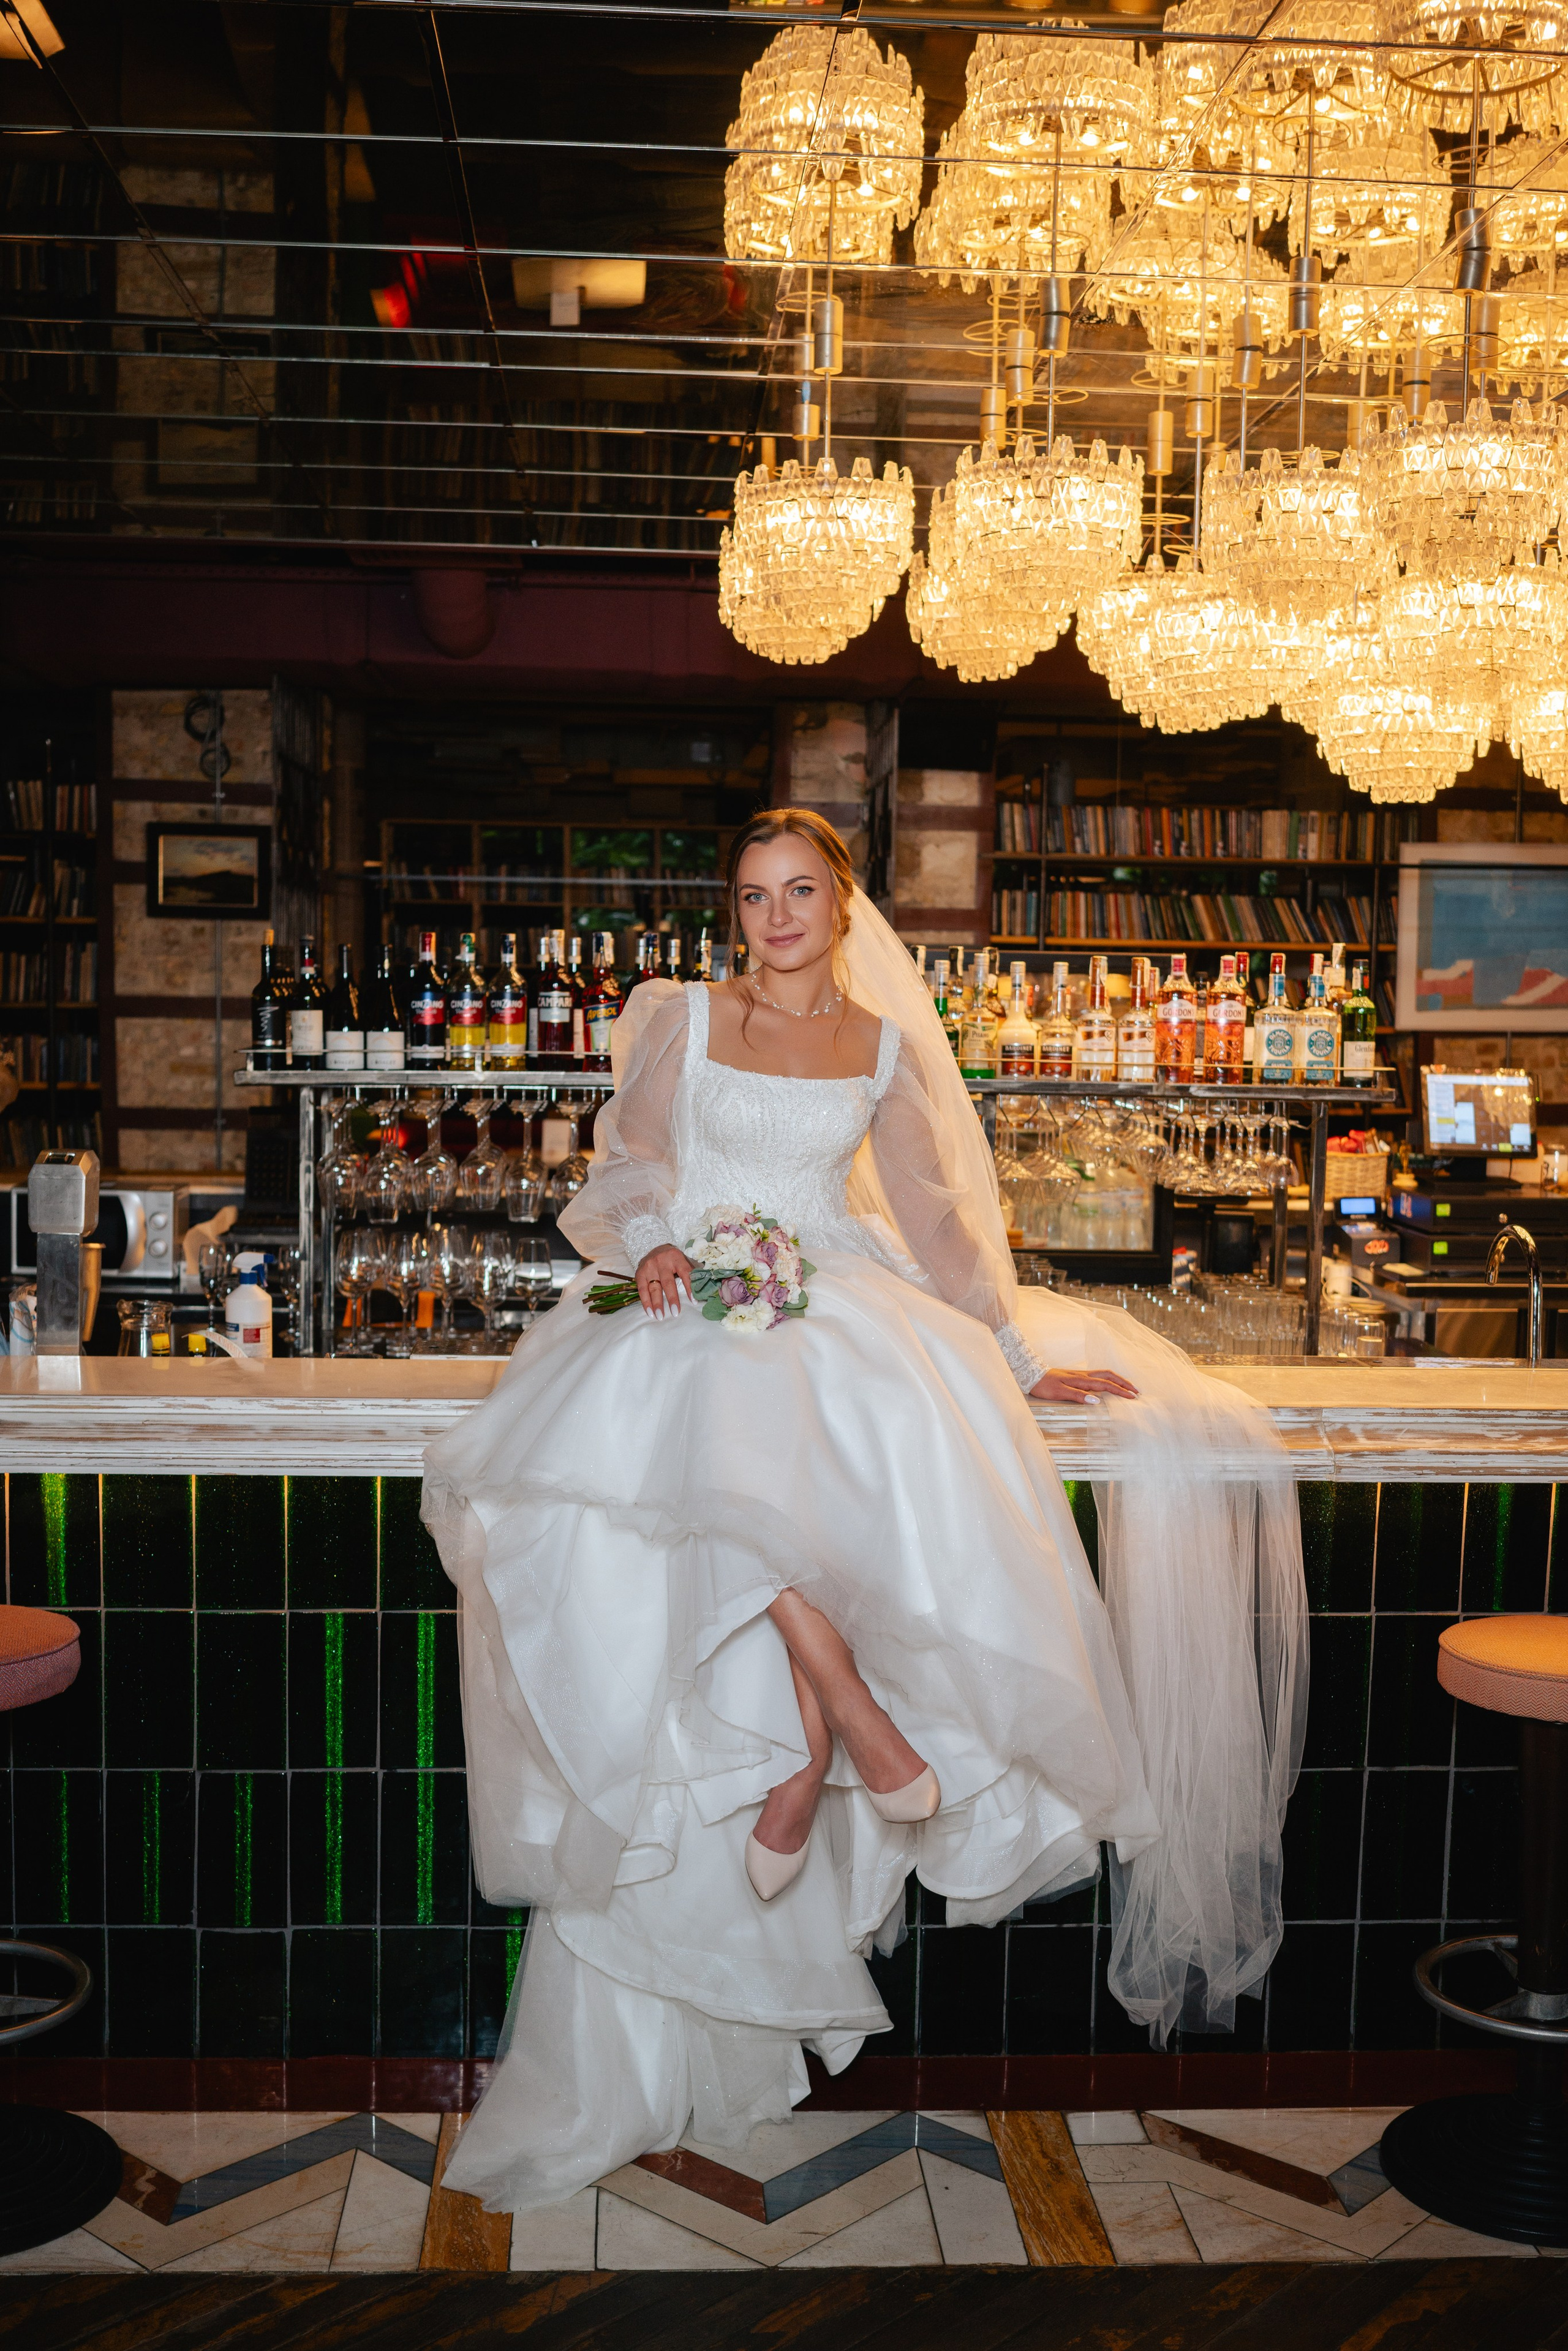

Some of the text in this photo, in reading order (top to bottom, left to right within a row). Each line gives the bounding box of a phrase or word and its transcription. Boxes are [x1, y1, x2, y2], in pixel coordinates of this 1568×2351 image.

[411, 998, 444, 1009] CINZANO
[450, 998, 483, 1009] CINZANO
[491, 998, 523, 1009] CINZANO
[538, 997, 573, 1008] CAMPARI
[586, 1006, 617, 1021] APEROL
[1268, 1030, 1289, 1040] OLMECA
[1310, 1032, 1331, 1041] OLMECA
[1268, 1044, 1290, 1054] TEQUILA
[1310, 1046, 1332, 1055] TEQUILA
